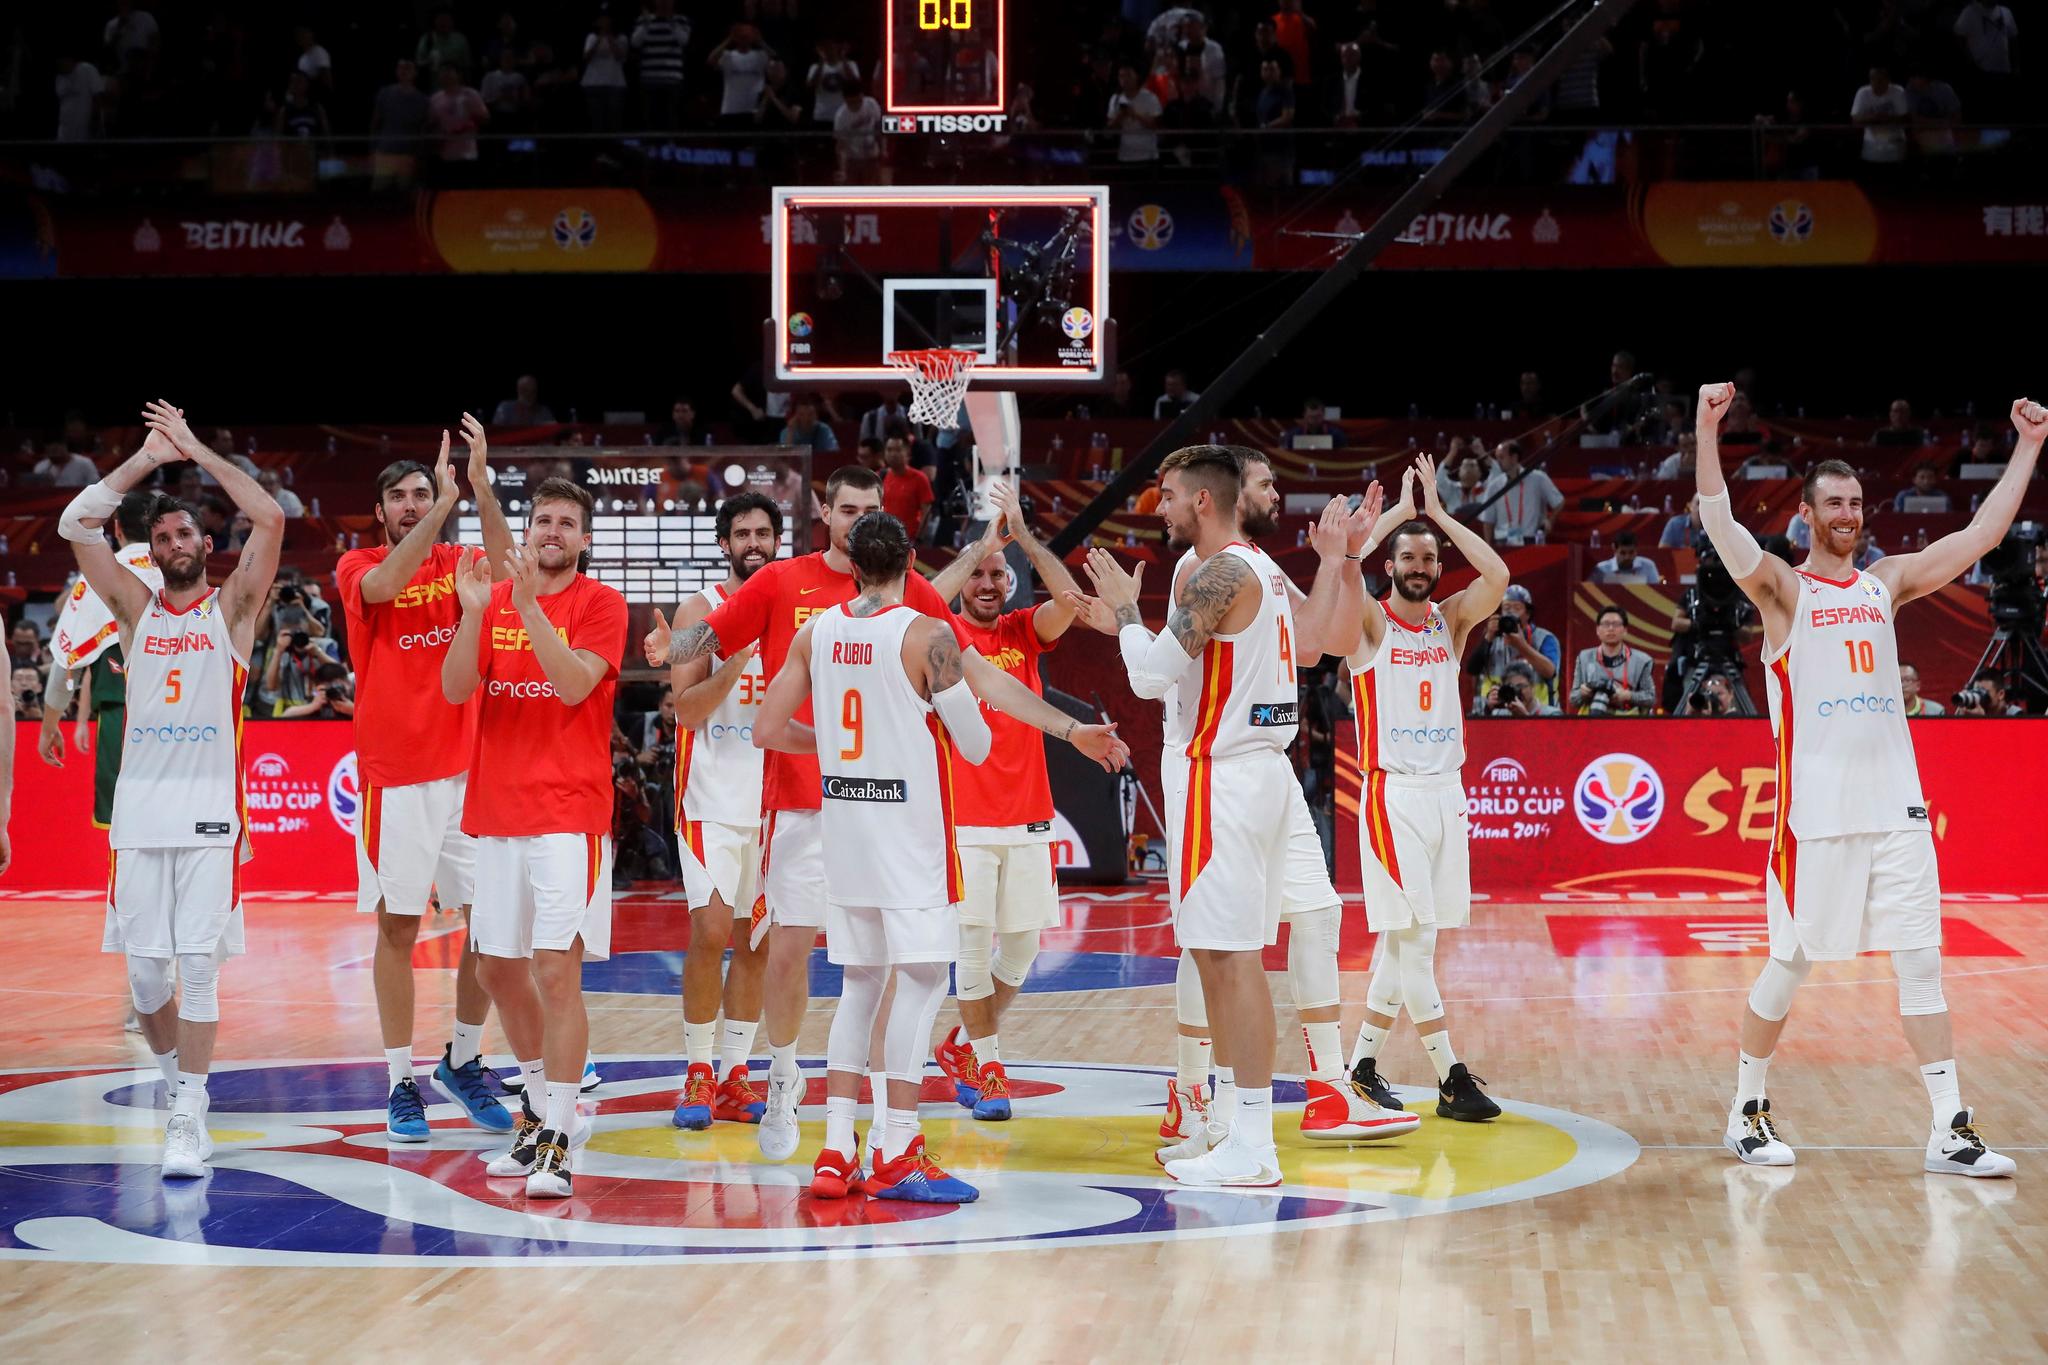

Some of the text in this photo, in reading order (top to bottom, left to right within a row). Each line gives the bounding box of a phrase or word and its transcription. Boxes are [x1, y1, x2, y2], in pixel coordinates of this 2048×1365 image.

[919, 0, 971, 29] 0.0
[917, 115, 1007, 132] TISSOT
[1811, 603, 1886, 628] ESPAÑA
[144, 632, 215, 656] ESPAÑA
[832, 641, 873, 665] RUBIO
[1391, 646, 1449, 667] ESPAÑA
[1844, 640, 1875, 674] 10
[165, 668, 182, 704] 5
[1419, 680, 1432, 711] 8
[131, 723, 217, 744] endesa
[840, 687, 863, 762] 9
[258, 763, 282, 777] FIBA
[1491, 768, 1518, 782] FIBA
[286, 792, 322, 809] CUP
[828, 778, 904, 801] CaixaBank
[1469, 786, 1562, 796] SKETBALL
[1467, 797, 1565, 815] ORLD CUP
[1513, 821, 1551, 839] 2019
